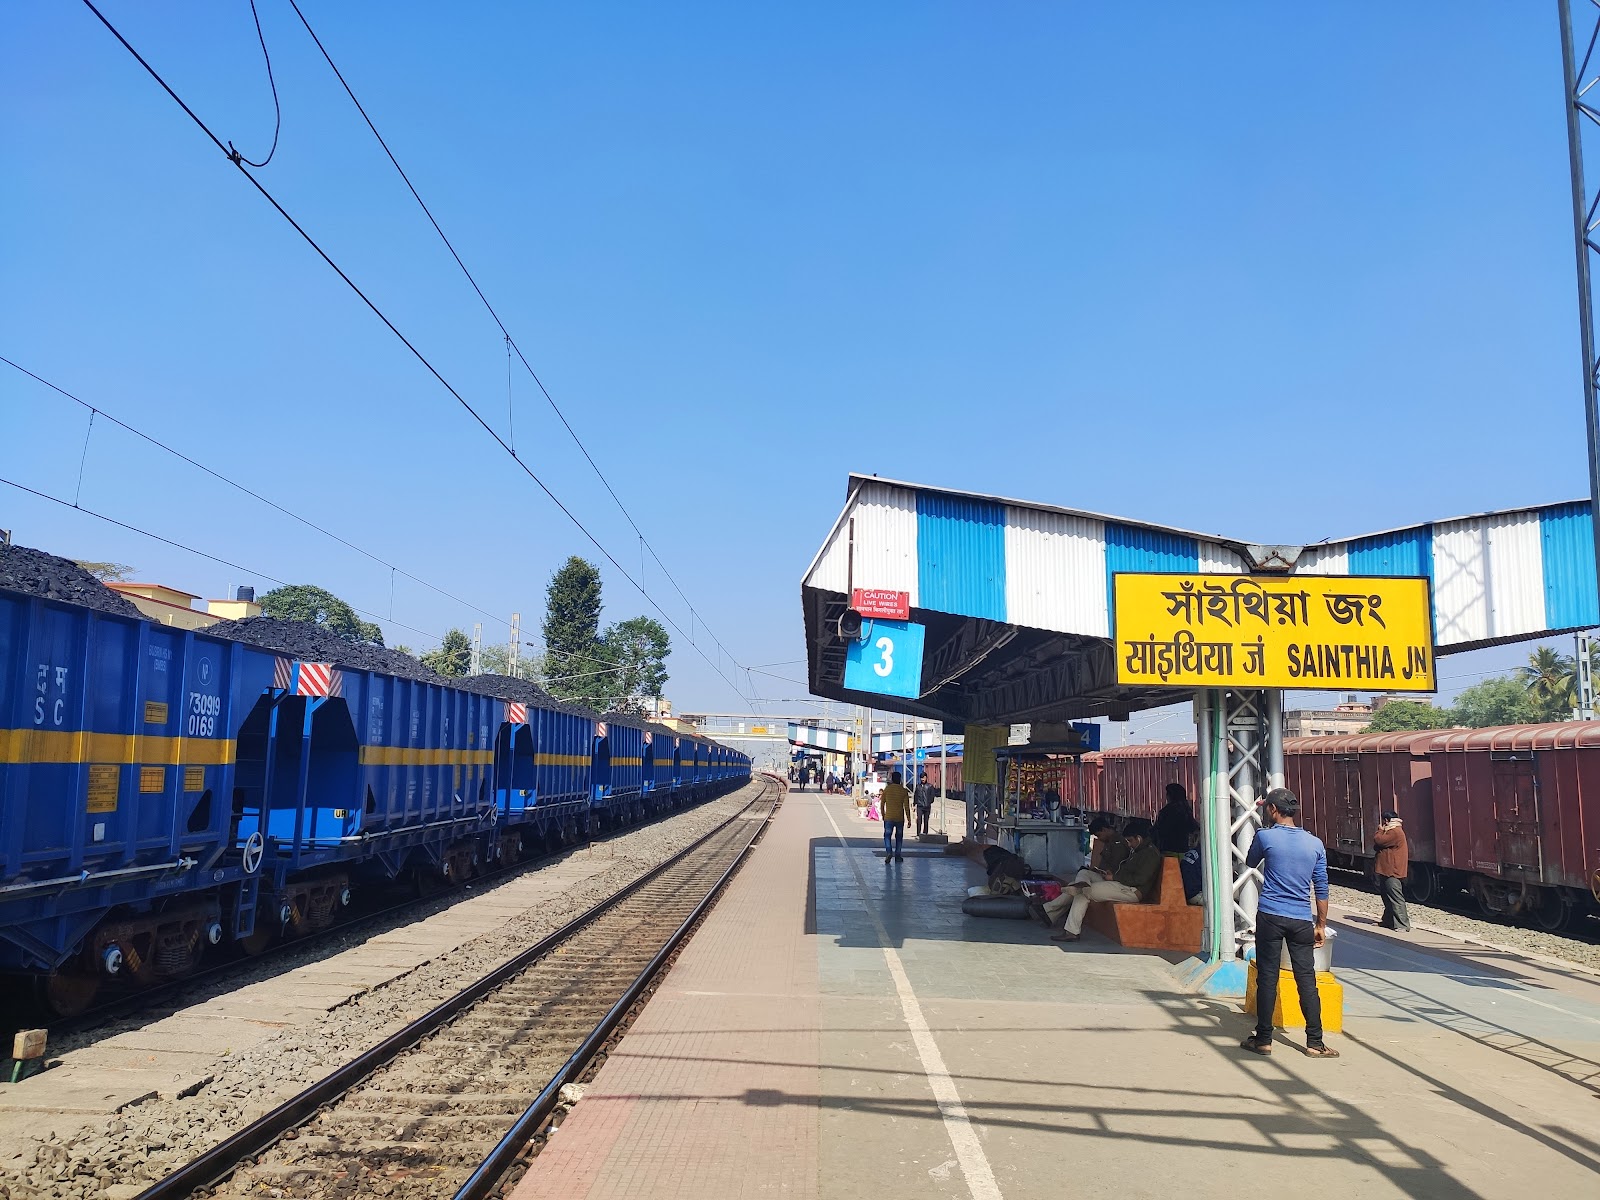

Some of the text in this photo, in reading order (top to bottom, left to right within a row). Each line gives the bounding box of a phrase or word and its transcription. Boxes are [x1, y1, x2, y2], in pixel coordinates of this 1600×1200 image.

[864, 592, 898, 600] CAUTION
[1160, 578, 1386, 629] সাঁইথিয়া জং
[873, 636, 894, 677] 3
[1241, 633, 1265, 676] जं
[1287, 643, 1427, 680] SAINTHIA JN
[188, 714, 214, 737] 0169
[1080, 729, 1091, 745] 4
